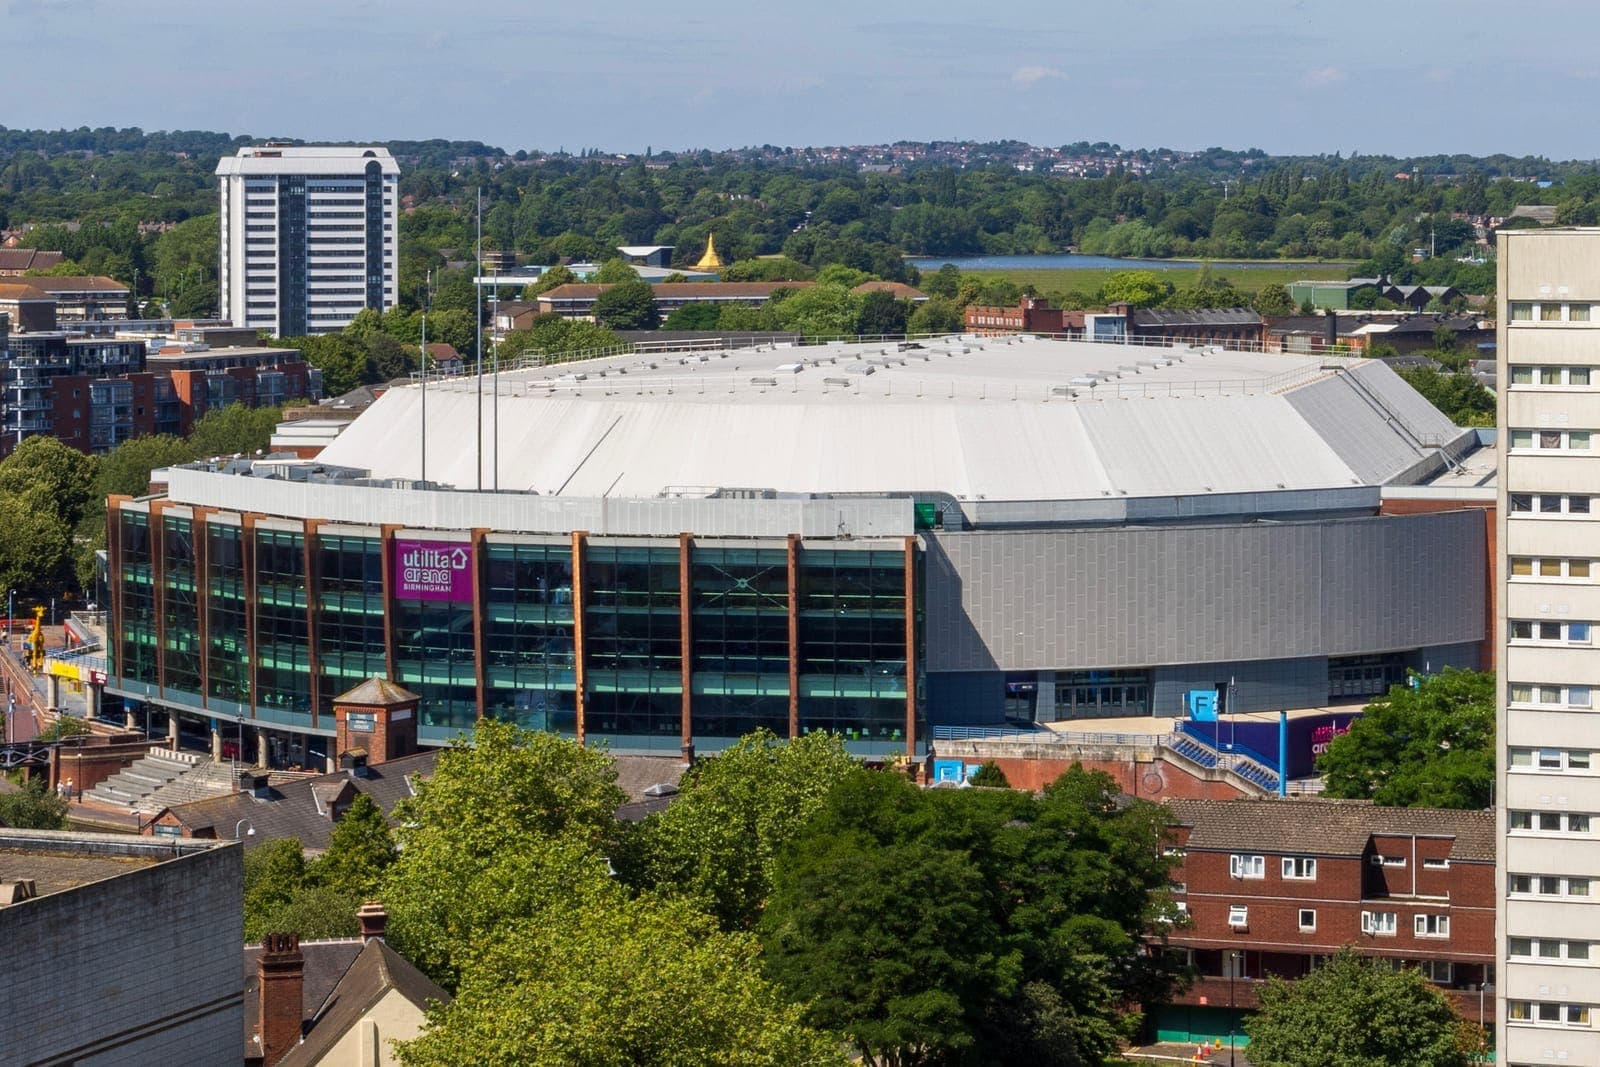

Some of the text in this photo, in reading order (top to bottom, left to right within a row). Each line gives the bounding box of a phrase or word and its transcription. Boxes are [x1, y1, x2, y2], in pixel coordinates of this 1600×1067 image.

[403, 550, 449, 568] utilita
[403, 567, 450, 584] arena
[403, 583, 452, 592] BIRMINGHAM
[1195, 696, 1208, 714] F
